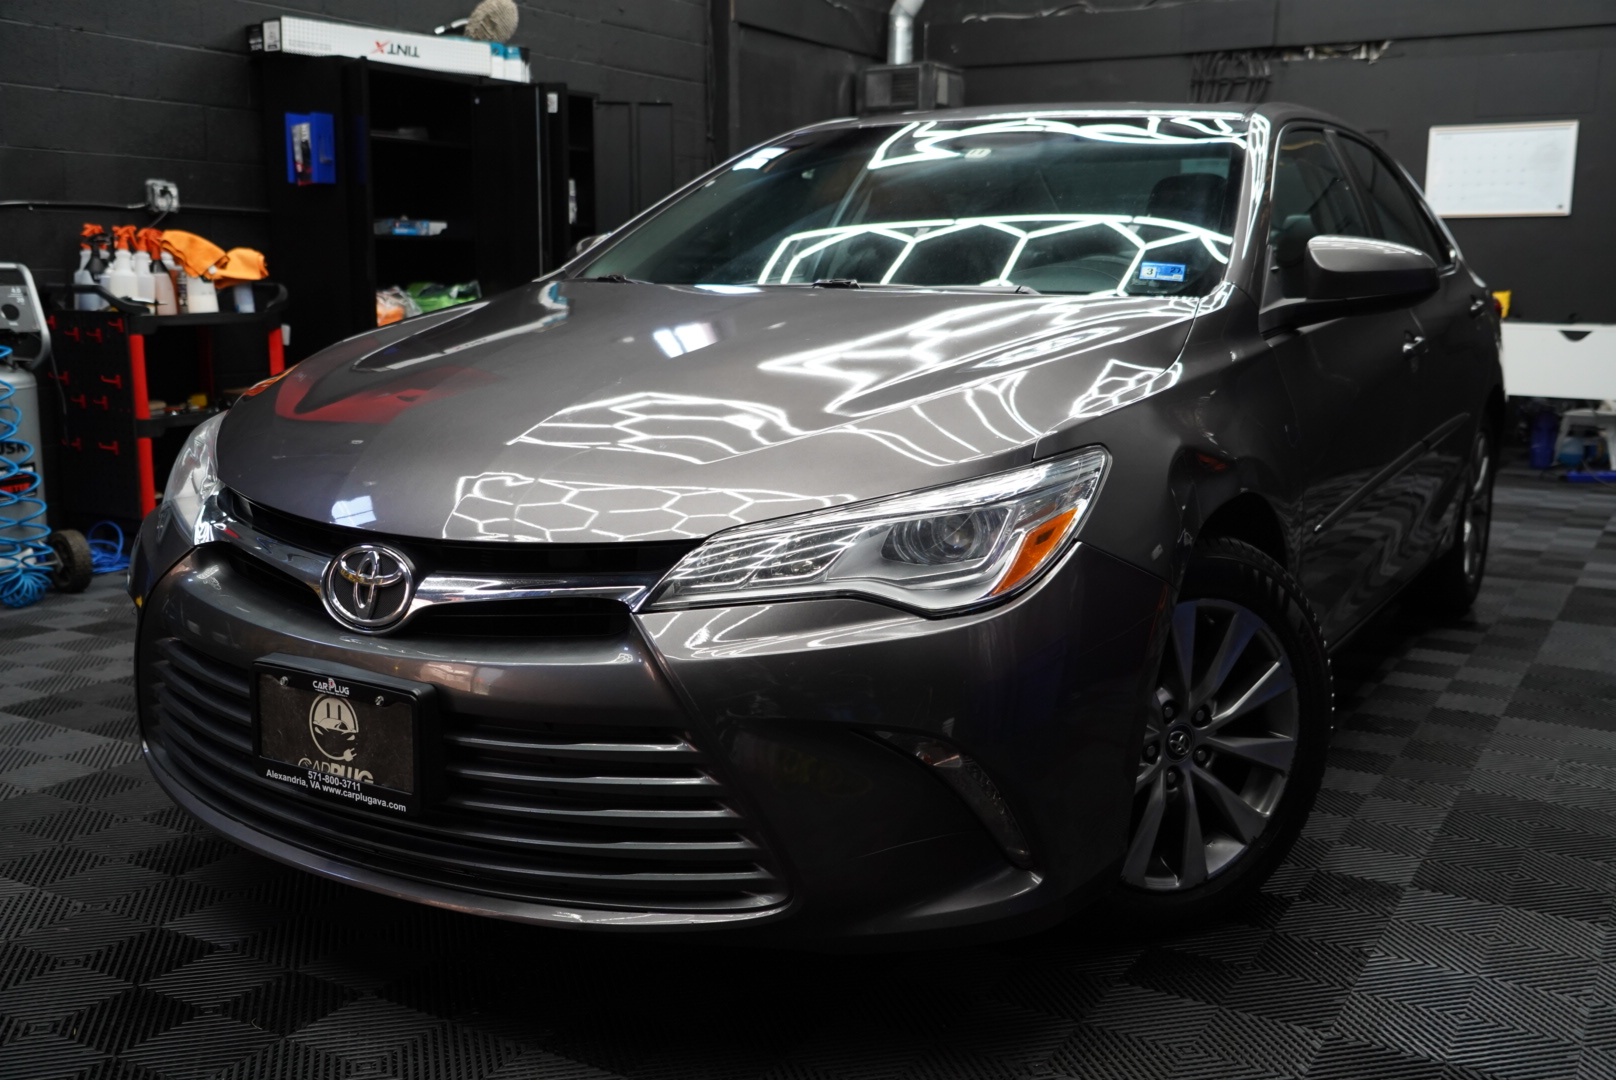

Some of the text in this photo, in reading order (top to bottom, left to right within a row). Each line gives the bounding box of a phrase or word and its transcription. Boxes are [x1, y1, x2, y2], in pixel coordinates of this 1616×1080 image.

[1146, 267, 1154, 275] 3
[266, 769, 407, 812] Alexandria, VA www.carplugava.com
[307, 770, 361, 792] 571-800-3711
